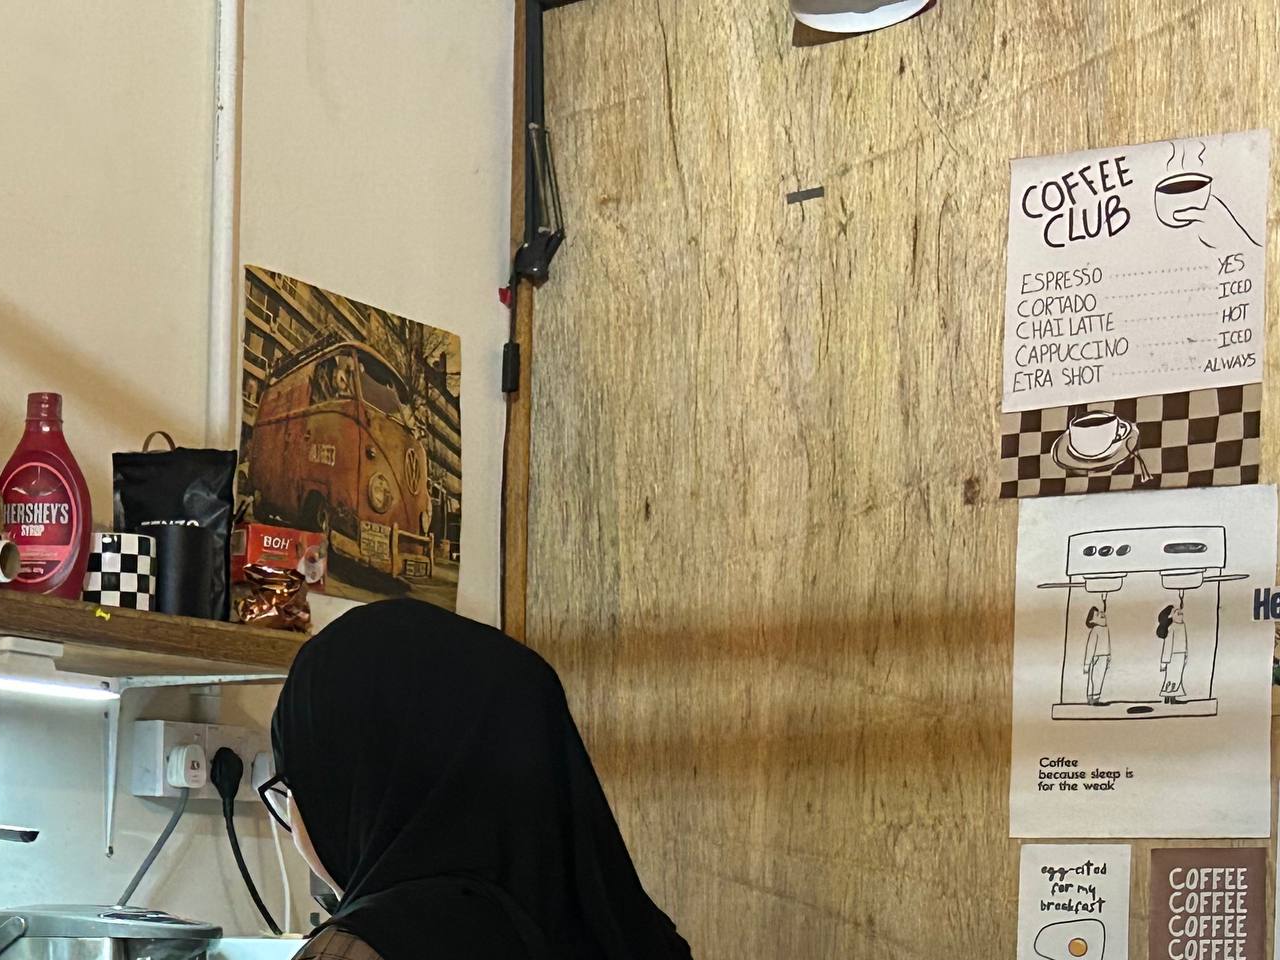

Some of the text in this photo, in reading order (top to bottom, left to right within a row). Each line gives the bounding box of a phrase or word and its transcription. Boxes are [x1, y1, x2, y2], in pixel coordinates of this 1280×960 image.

[1021, 156, 1134, 219] COFFEE
[1043, 195, 1131, 248] CLUB
[1021, 253, 1245, 295] ESPRESSO YES
[1017, 279, 1252, 318] CORTADO ICED
[1016, 303, 1250, 340] CHAI LATTE HOT
[1015, 329, 1252, 367] CAPPUCCINO ICED
[1012, 352, 1257, 392] ETRA SHOT ALWAYS
[3, 502, 69, 524] HERSHEY'S
[1039, 757, 1078, 768] Coffee
[1038, 767, 1134, 782] because sleep is
[1038, 780, 1115, 791] for the weak
[1041, 860, 1107, 882] egg-cited
[1169, 867, 1248, 890] COFFEE
[1051, 882, 1096, 901] for my
[1168, 891, 1247, 914] COFFEE
[1041, 897, 1106, 913] breakfast
[1168, 915, 1247, 938] COFFEE
[1168, 939, 1247, 960] COFFEE
